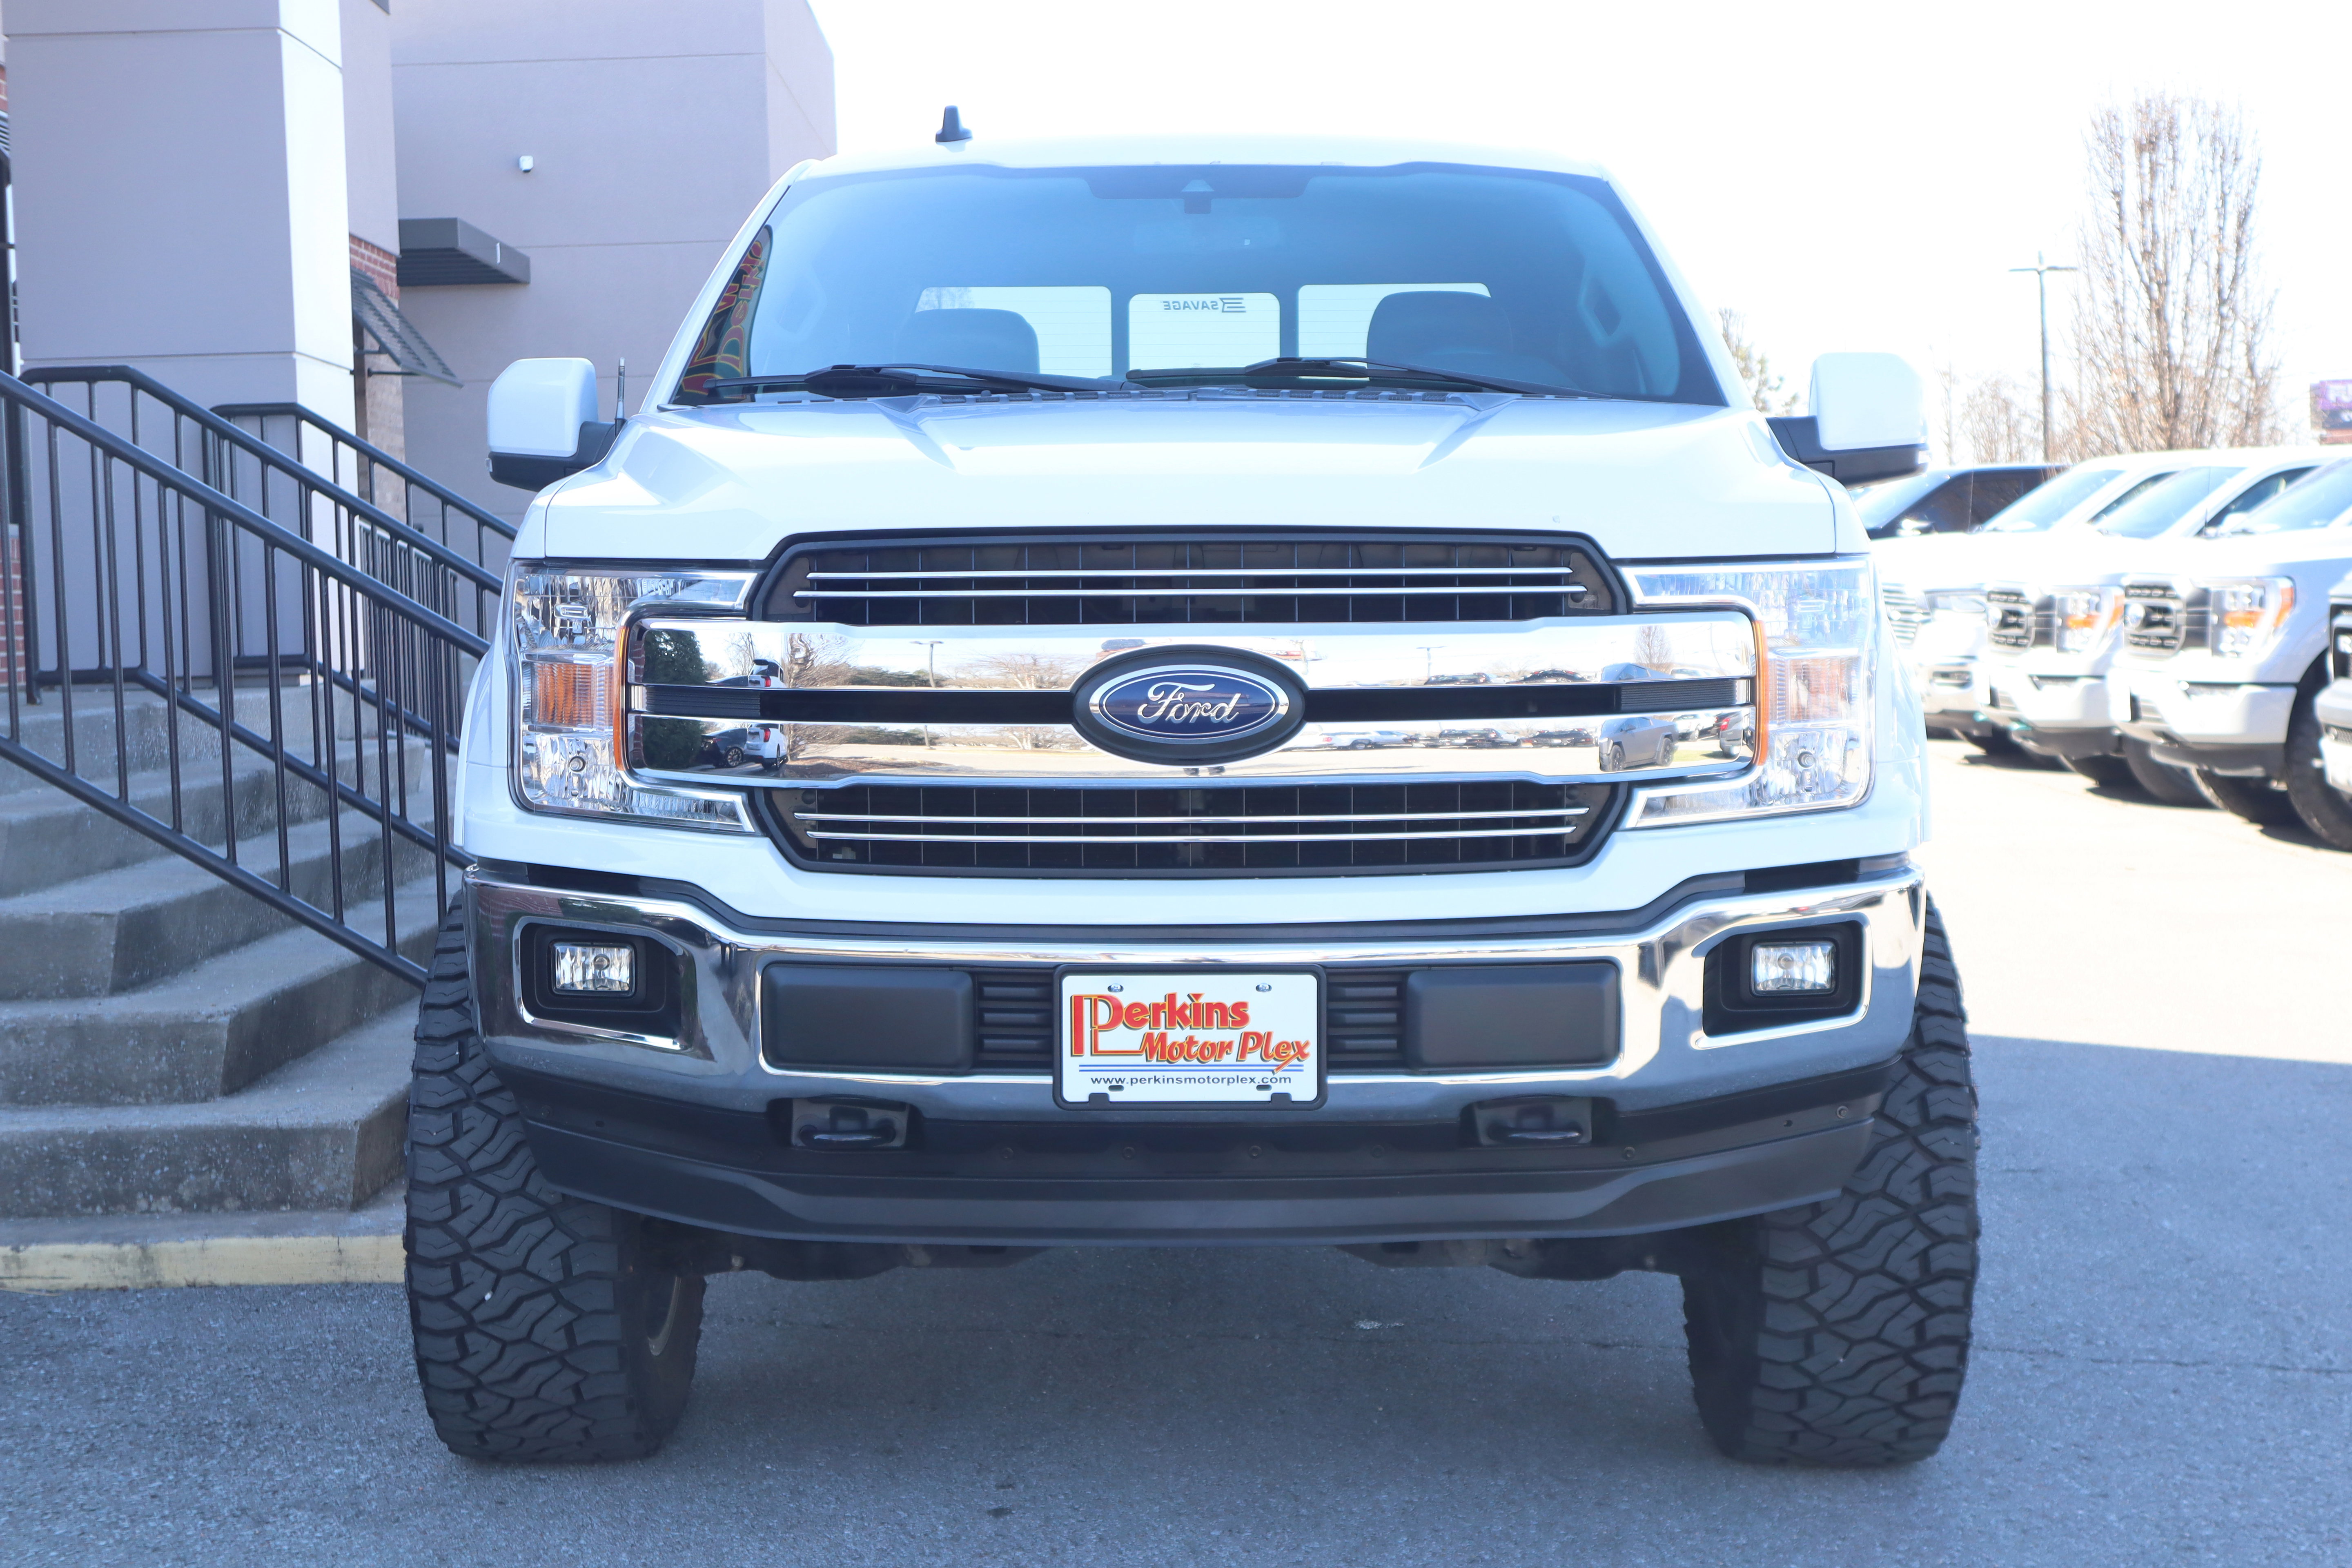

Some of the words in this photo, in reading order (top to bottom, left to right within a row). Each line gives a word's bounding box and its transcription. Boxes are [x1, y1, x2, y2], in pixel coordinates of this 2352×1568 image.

[1138, 682, 1242, 724] Ford
[1070, 992, 1251, 1057] Perkins
[1144, 1031, 1234, 1064] Motor
[1236, 1031, 1311, 1075] Plex
[1090, 1075, 1292, 1086] www.perkinsmotorplex.com
